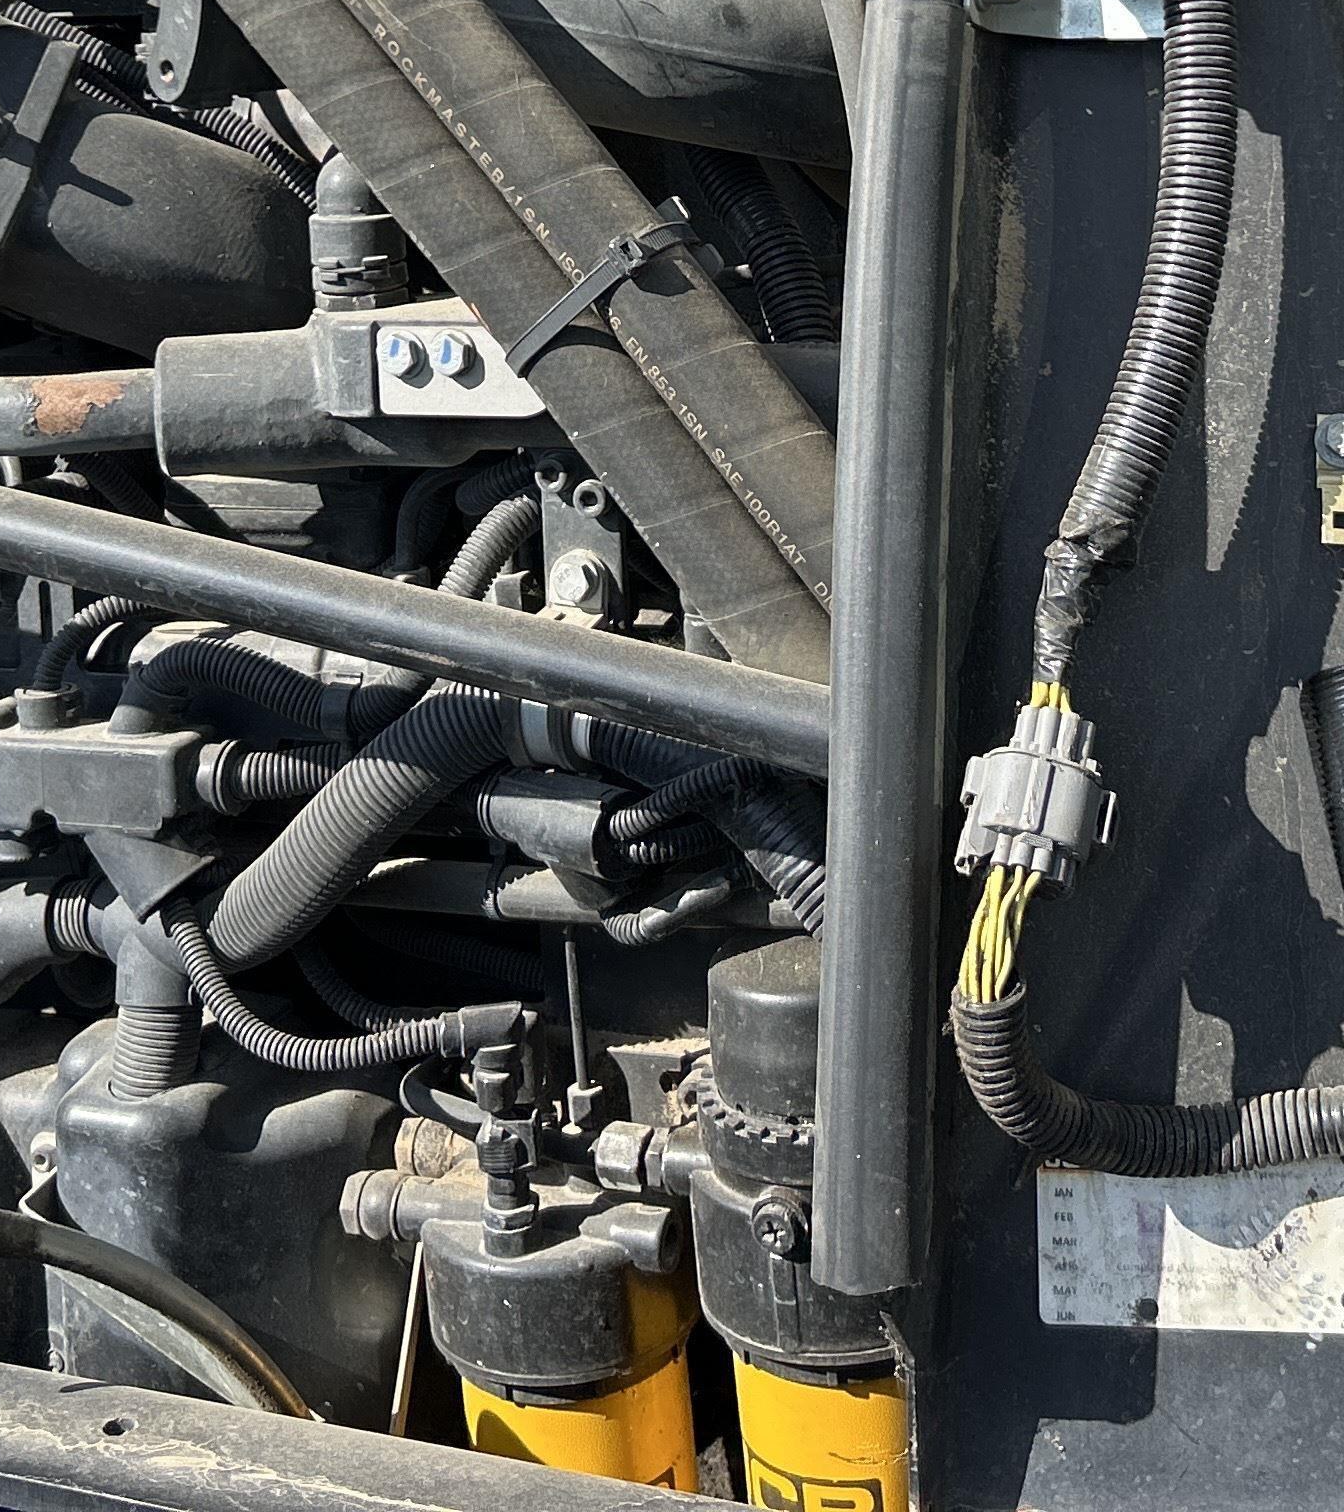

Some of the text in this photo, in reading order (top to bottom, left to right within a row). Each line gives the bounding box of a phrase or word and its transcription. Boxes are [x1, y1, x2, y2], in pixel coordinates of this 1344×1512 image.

[558, 251, 585, 284] ISO
[626, 336, 648, 365] EN
[648, 365, 676, 401] 853
[679, 404, 708, 440] 1SN
[712, 447, 744, 487] SAE
[744, 489, 806, 566] 100R1AT
[1054, 1187, 1074, 1198] JAN
[1054, 1211, 1074, 1222] FEB
